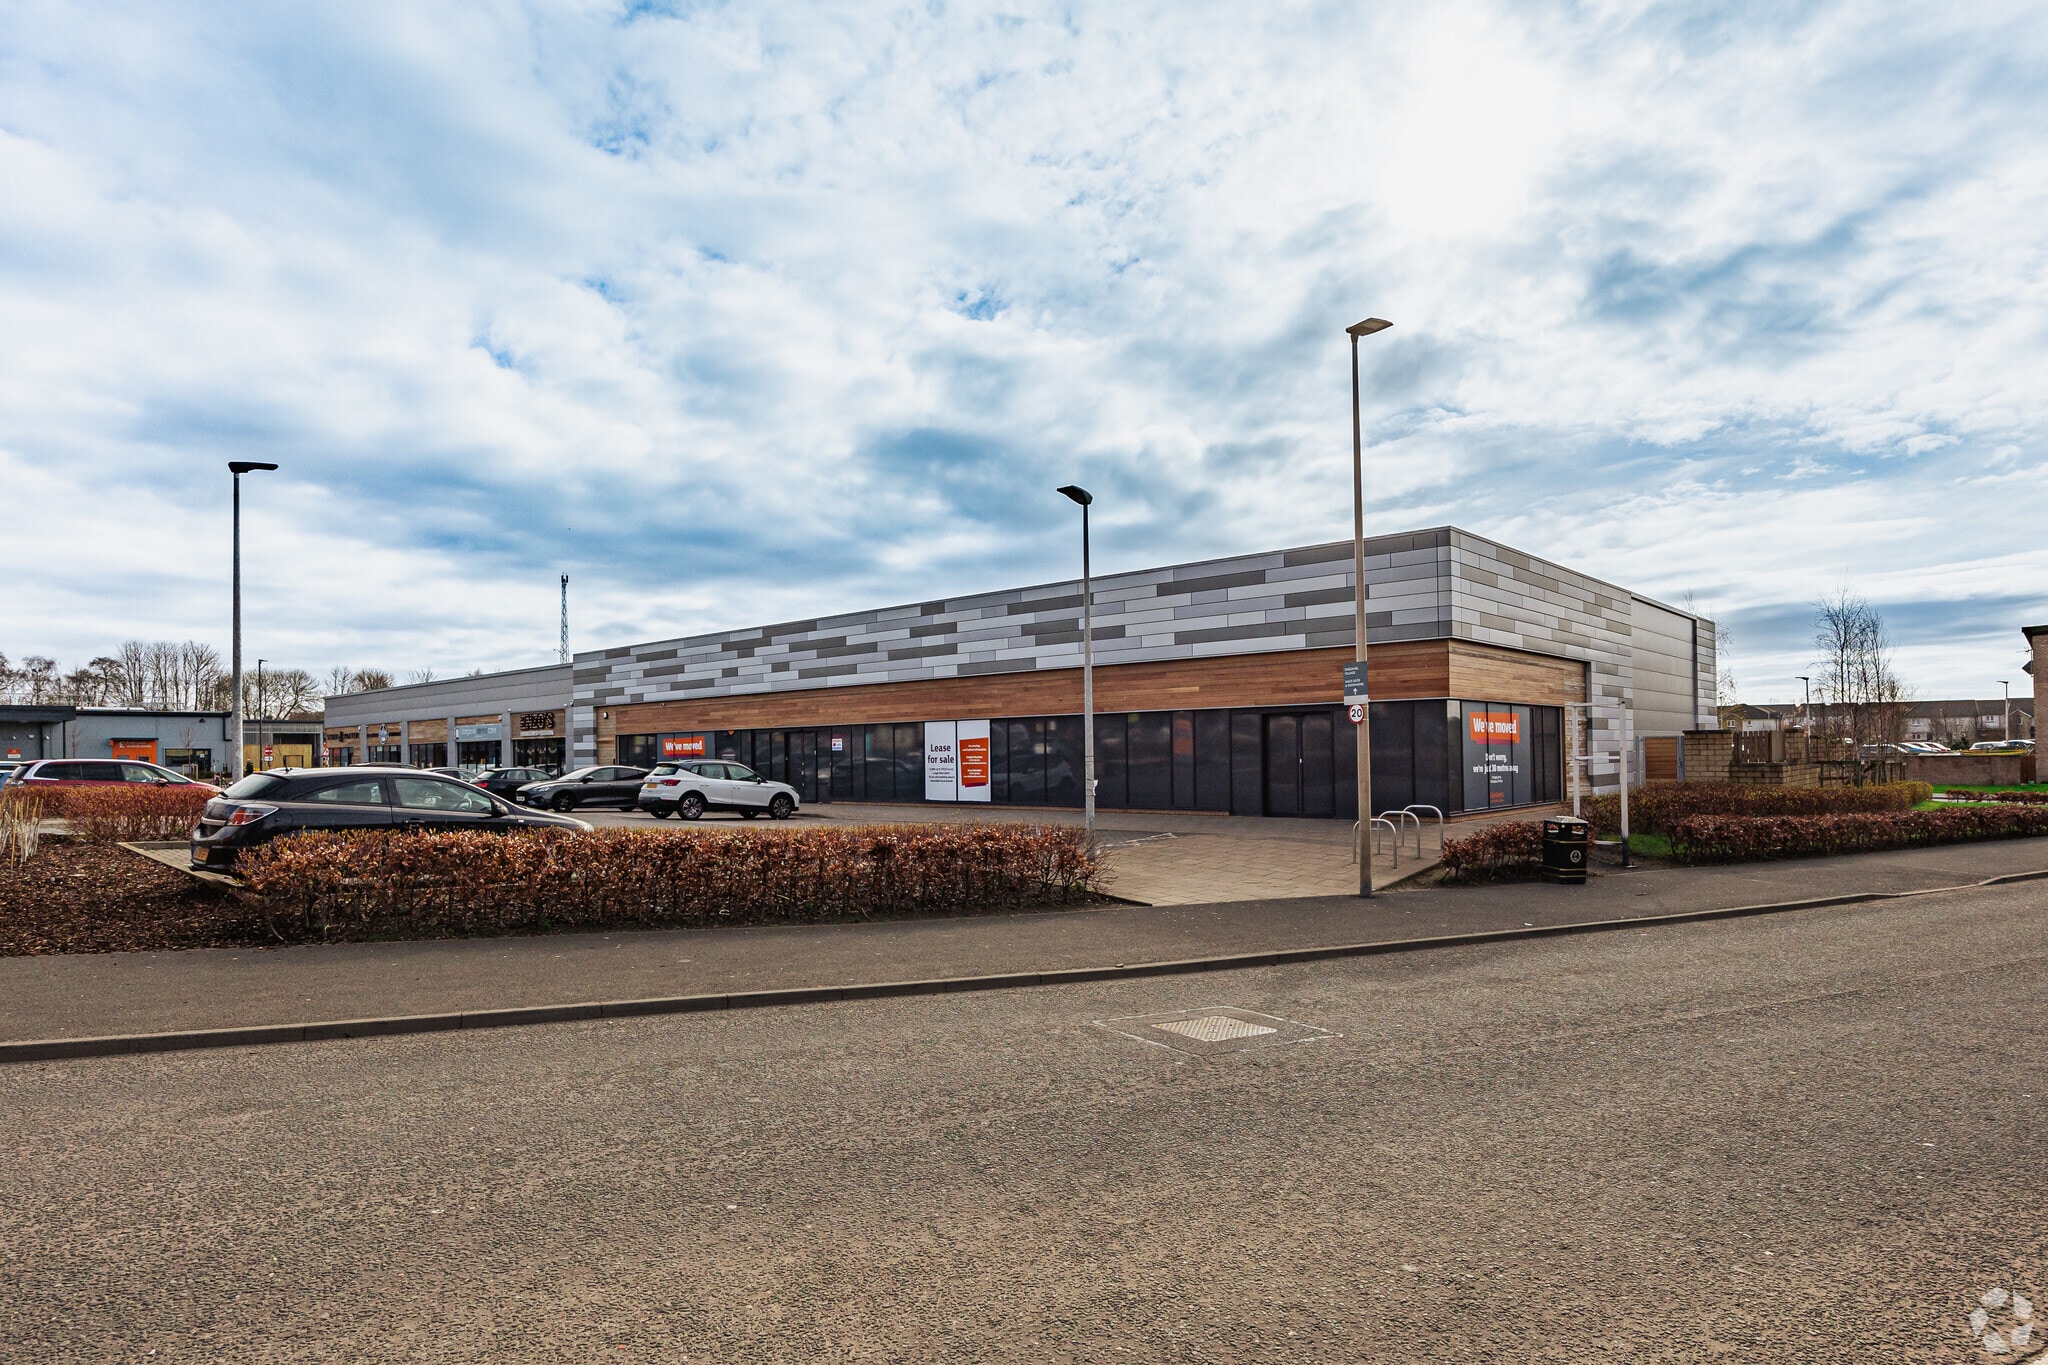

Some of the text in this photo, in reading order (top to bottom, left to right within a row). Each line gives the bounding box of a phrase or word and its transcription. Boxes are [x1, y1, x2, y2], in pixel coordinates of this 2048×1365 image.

[1351, 708, 1363, 718] 20
[1473, 717, 1517, 734] We've moved
[665, 740, 703, 751] We've moved
[930, 744, 952, 752] Lease
[927, 754, 955, 764] for sale
